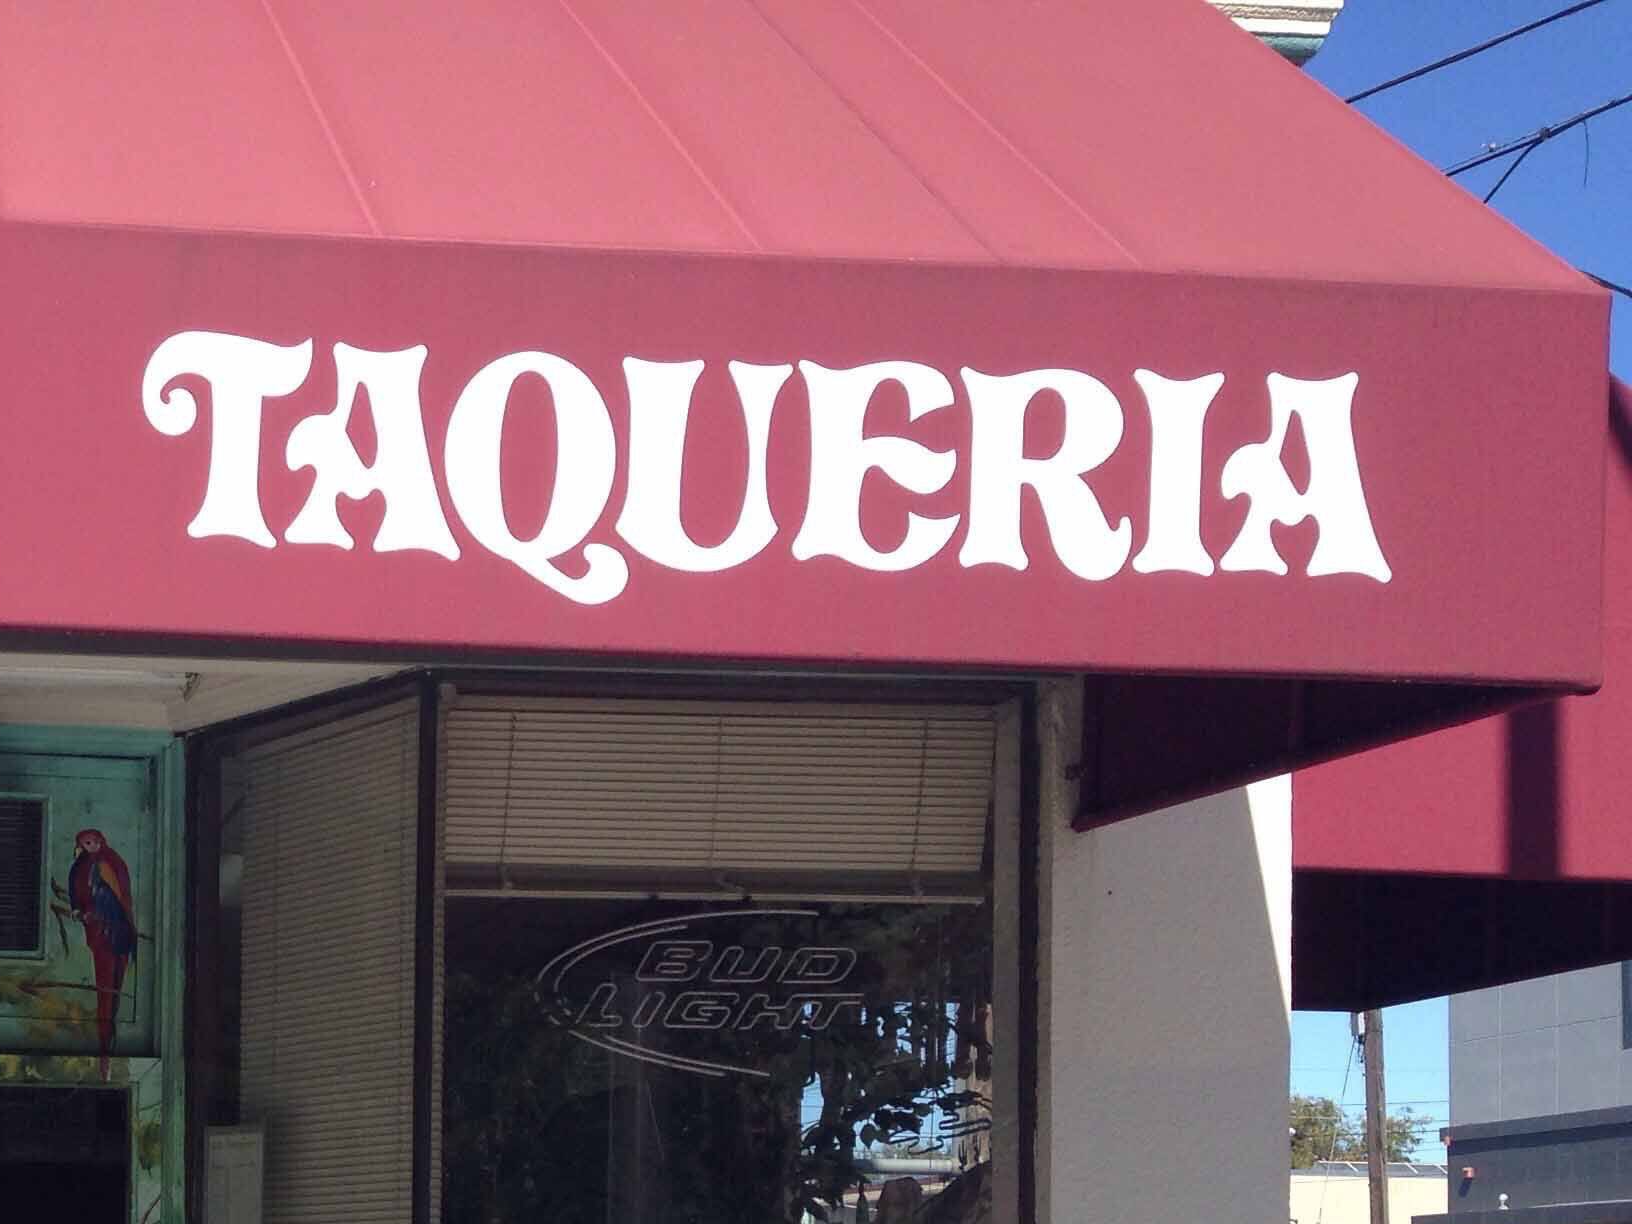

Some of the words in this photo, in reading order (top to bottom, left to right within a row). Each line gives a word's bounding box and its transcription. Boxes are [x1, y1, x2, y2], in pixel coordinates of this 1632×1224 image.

[142, 330, 1393, 605] TAQUERIA
[634, 939, 858, 983] BUD
[574, 982, 865, 1030] LIGHT
